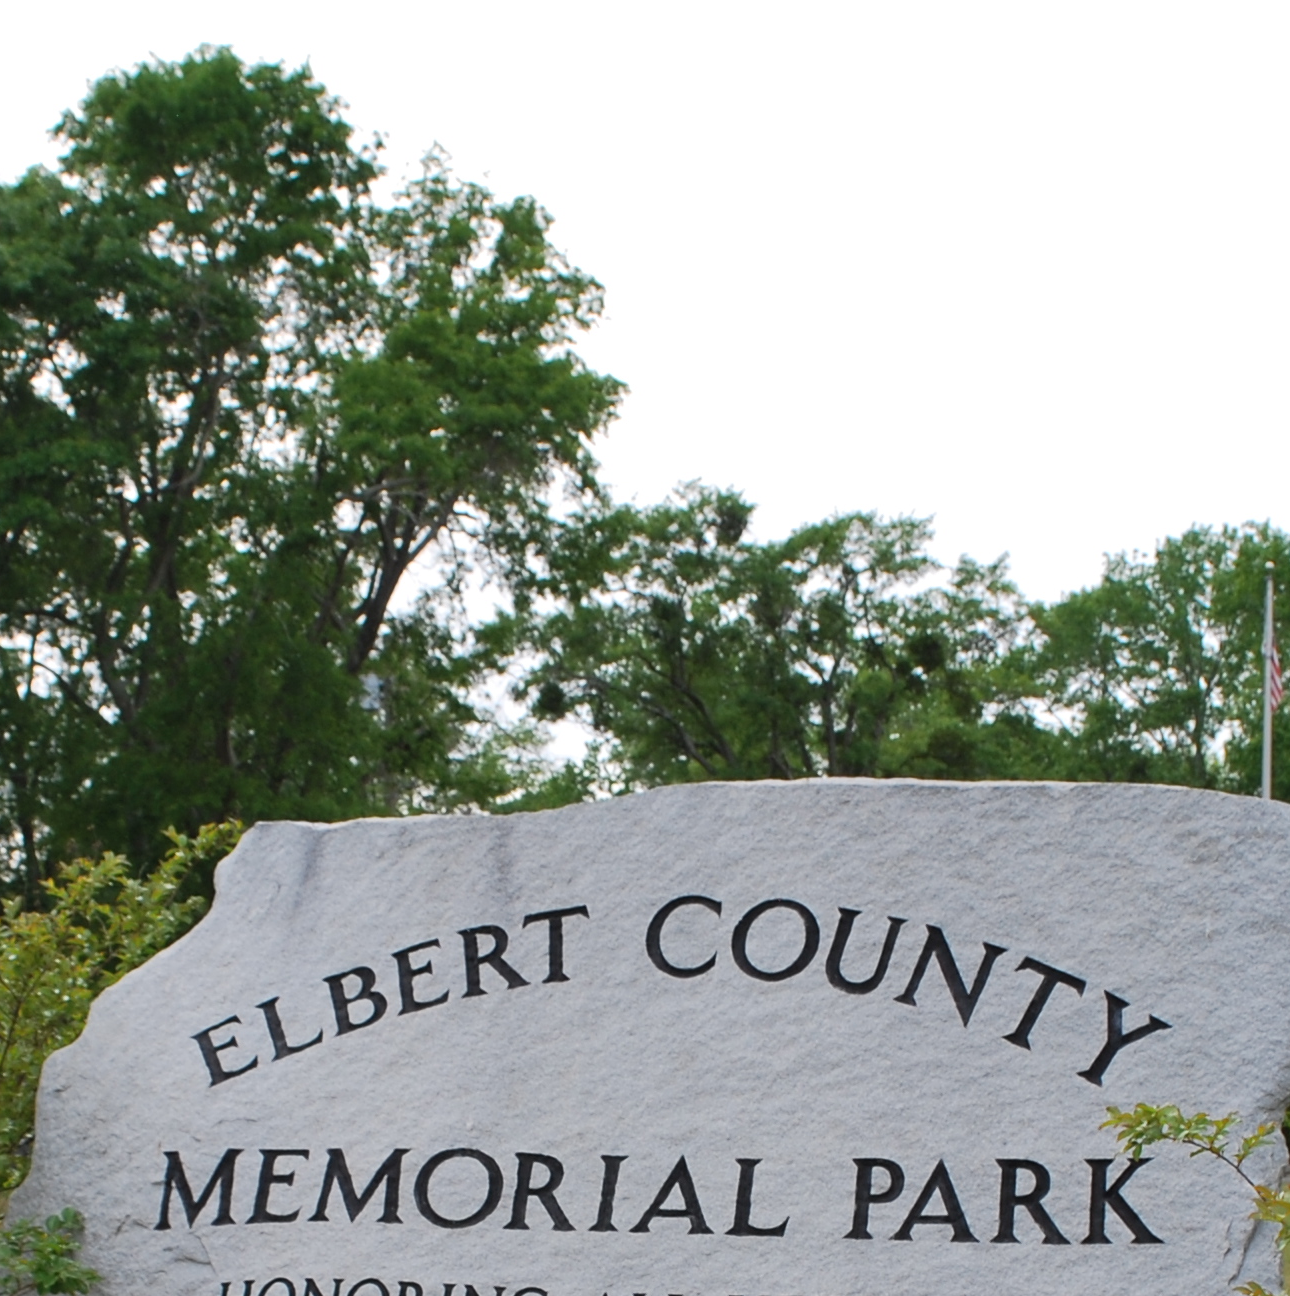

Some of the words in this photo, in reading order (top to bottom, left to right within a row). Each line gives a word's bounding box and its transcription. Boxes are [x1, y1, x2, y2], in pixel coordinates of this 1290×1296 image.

[190, 903, 590, 1088] ELBERT
[644, 893, 1173, 1088] COUNTY
[153, 1147, 790, 1238] MEMORIAL
[842, 1156, 1166, 1246] PARK
